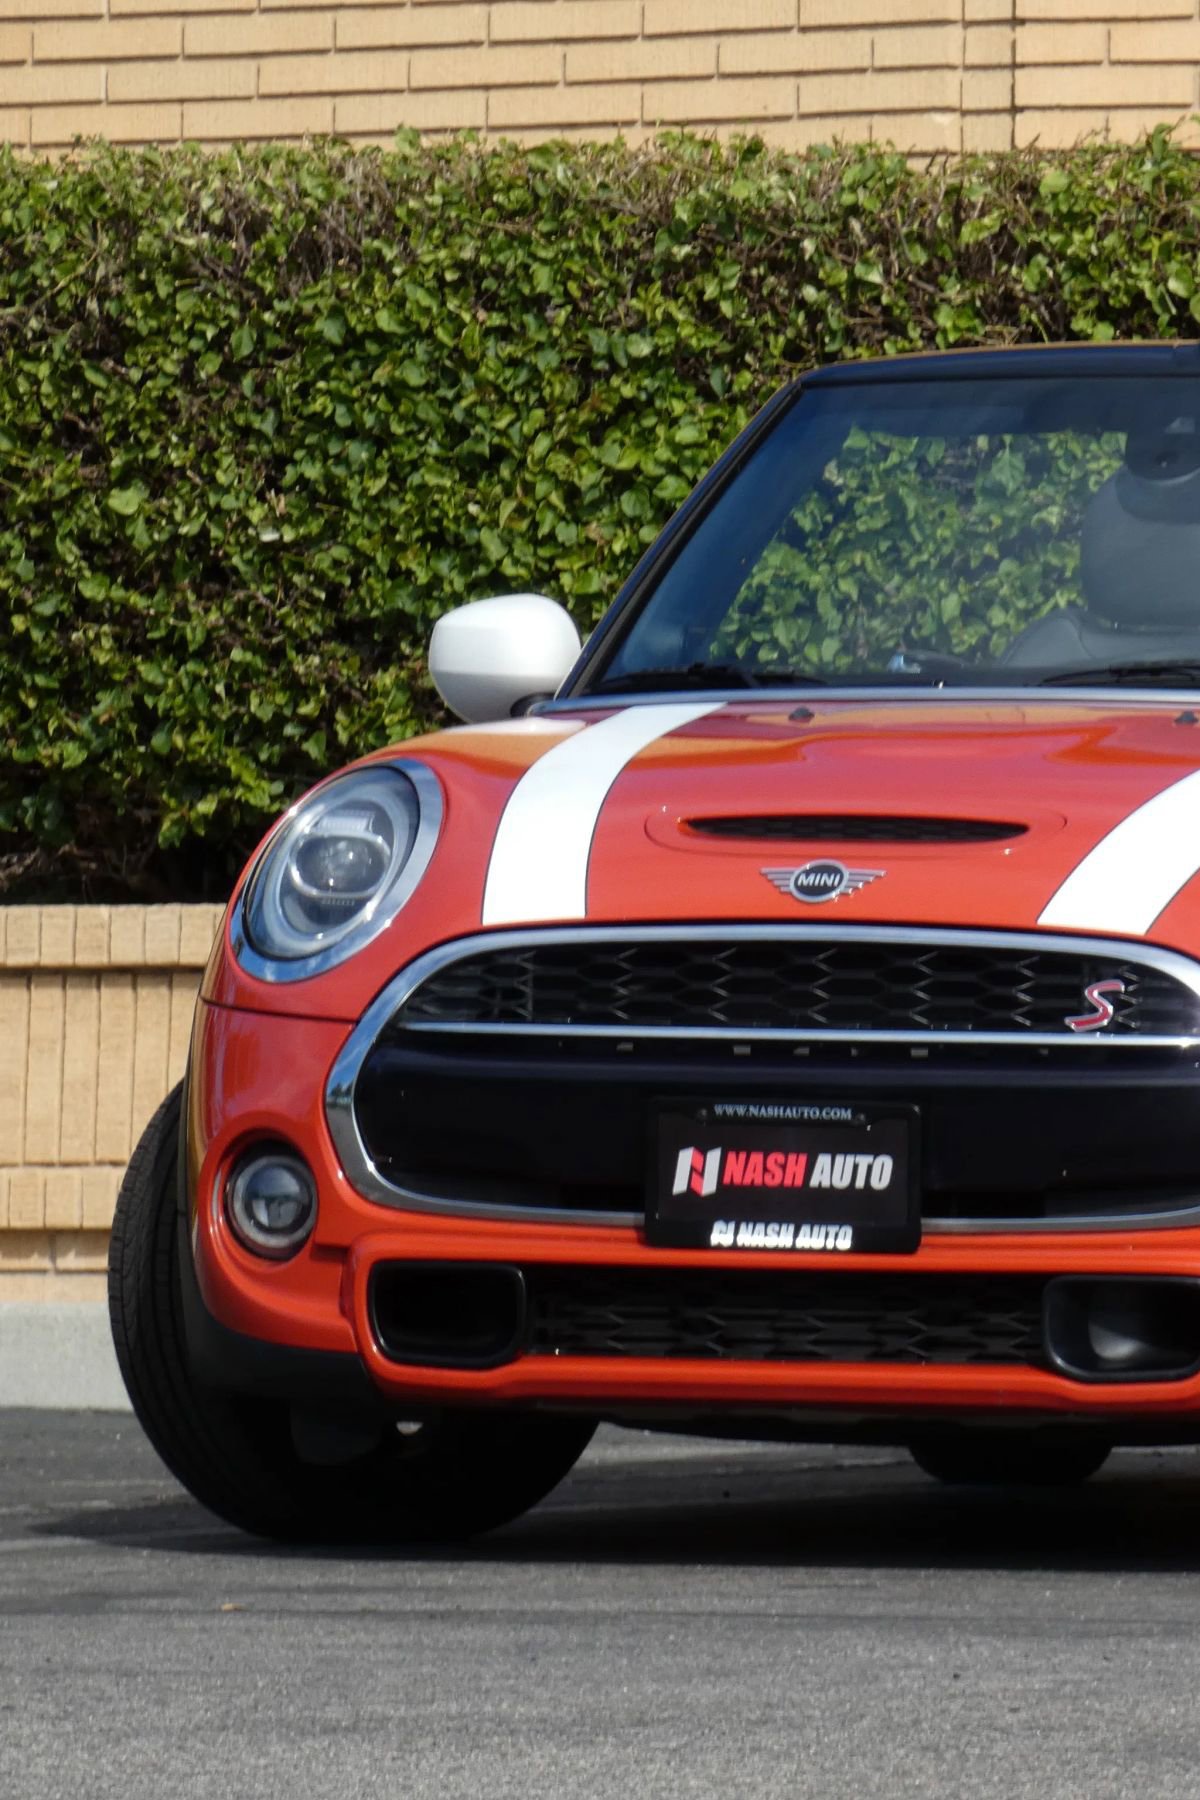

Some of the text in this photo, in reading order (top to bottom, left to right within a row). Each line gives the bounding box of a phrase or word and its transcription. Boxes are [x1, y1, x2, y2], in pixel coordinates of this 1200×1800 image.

[797, 872, 841, 887] MINI
[1064, 979, 1125, 1033] S
[713, 1103, 853, 1121] WWW.NASHAUTO.COM
[723, 1151, 808, 1188] NASH
[809, 1153, 894, 1190] AUTO
[736, 1221, 795, 1249] NASH
[795, 1223, 853, 1251] AUTO
